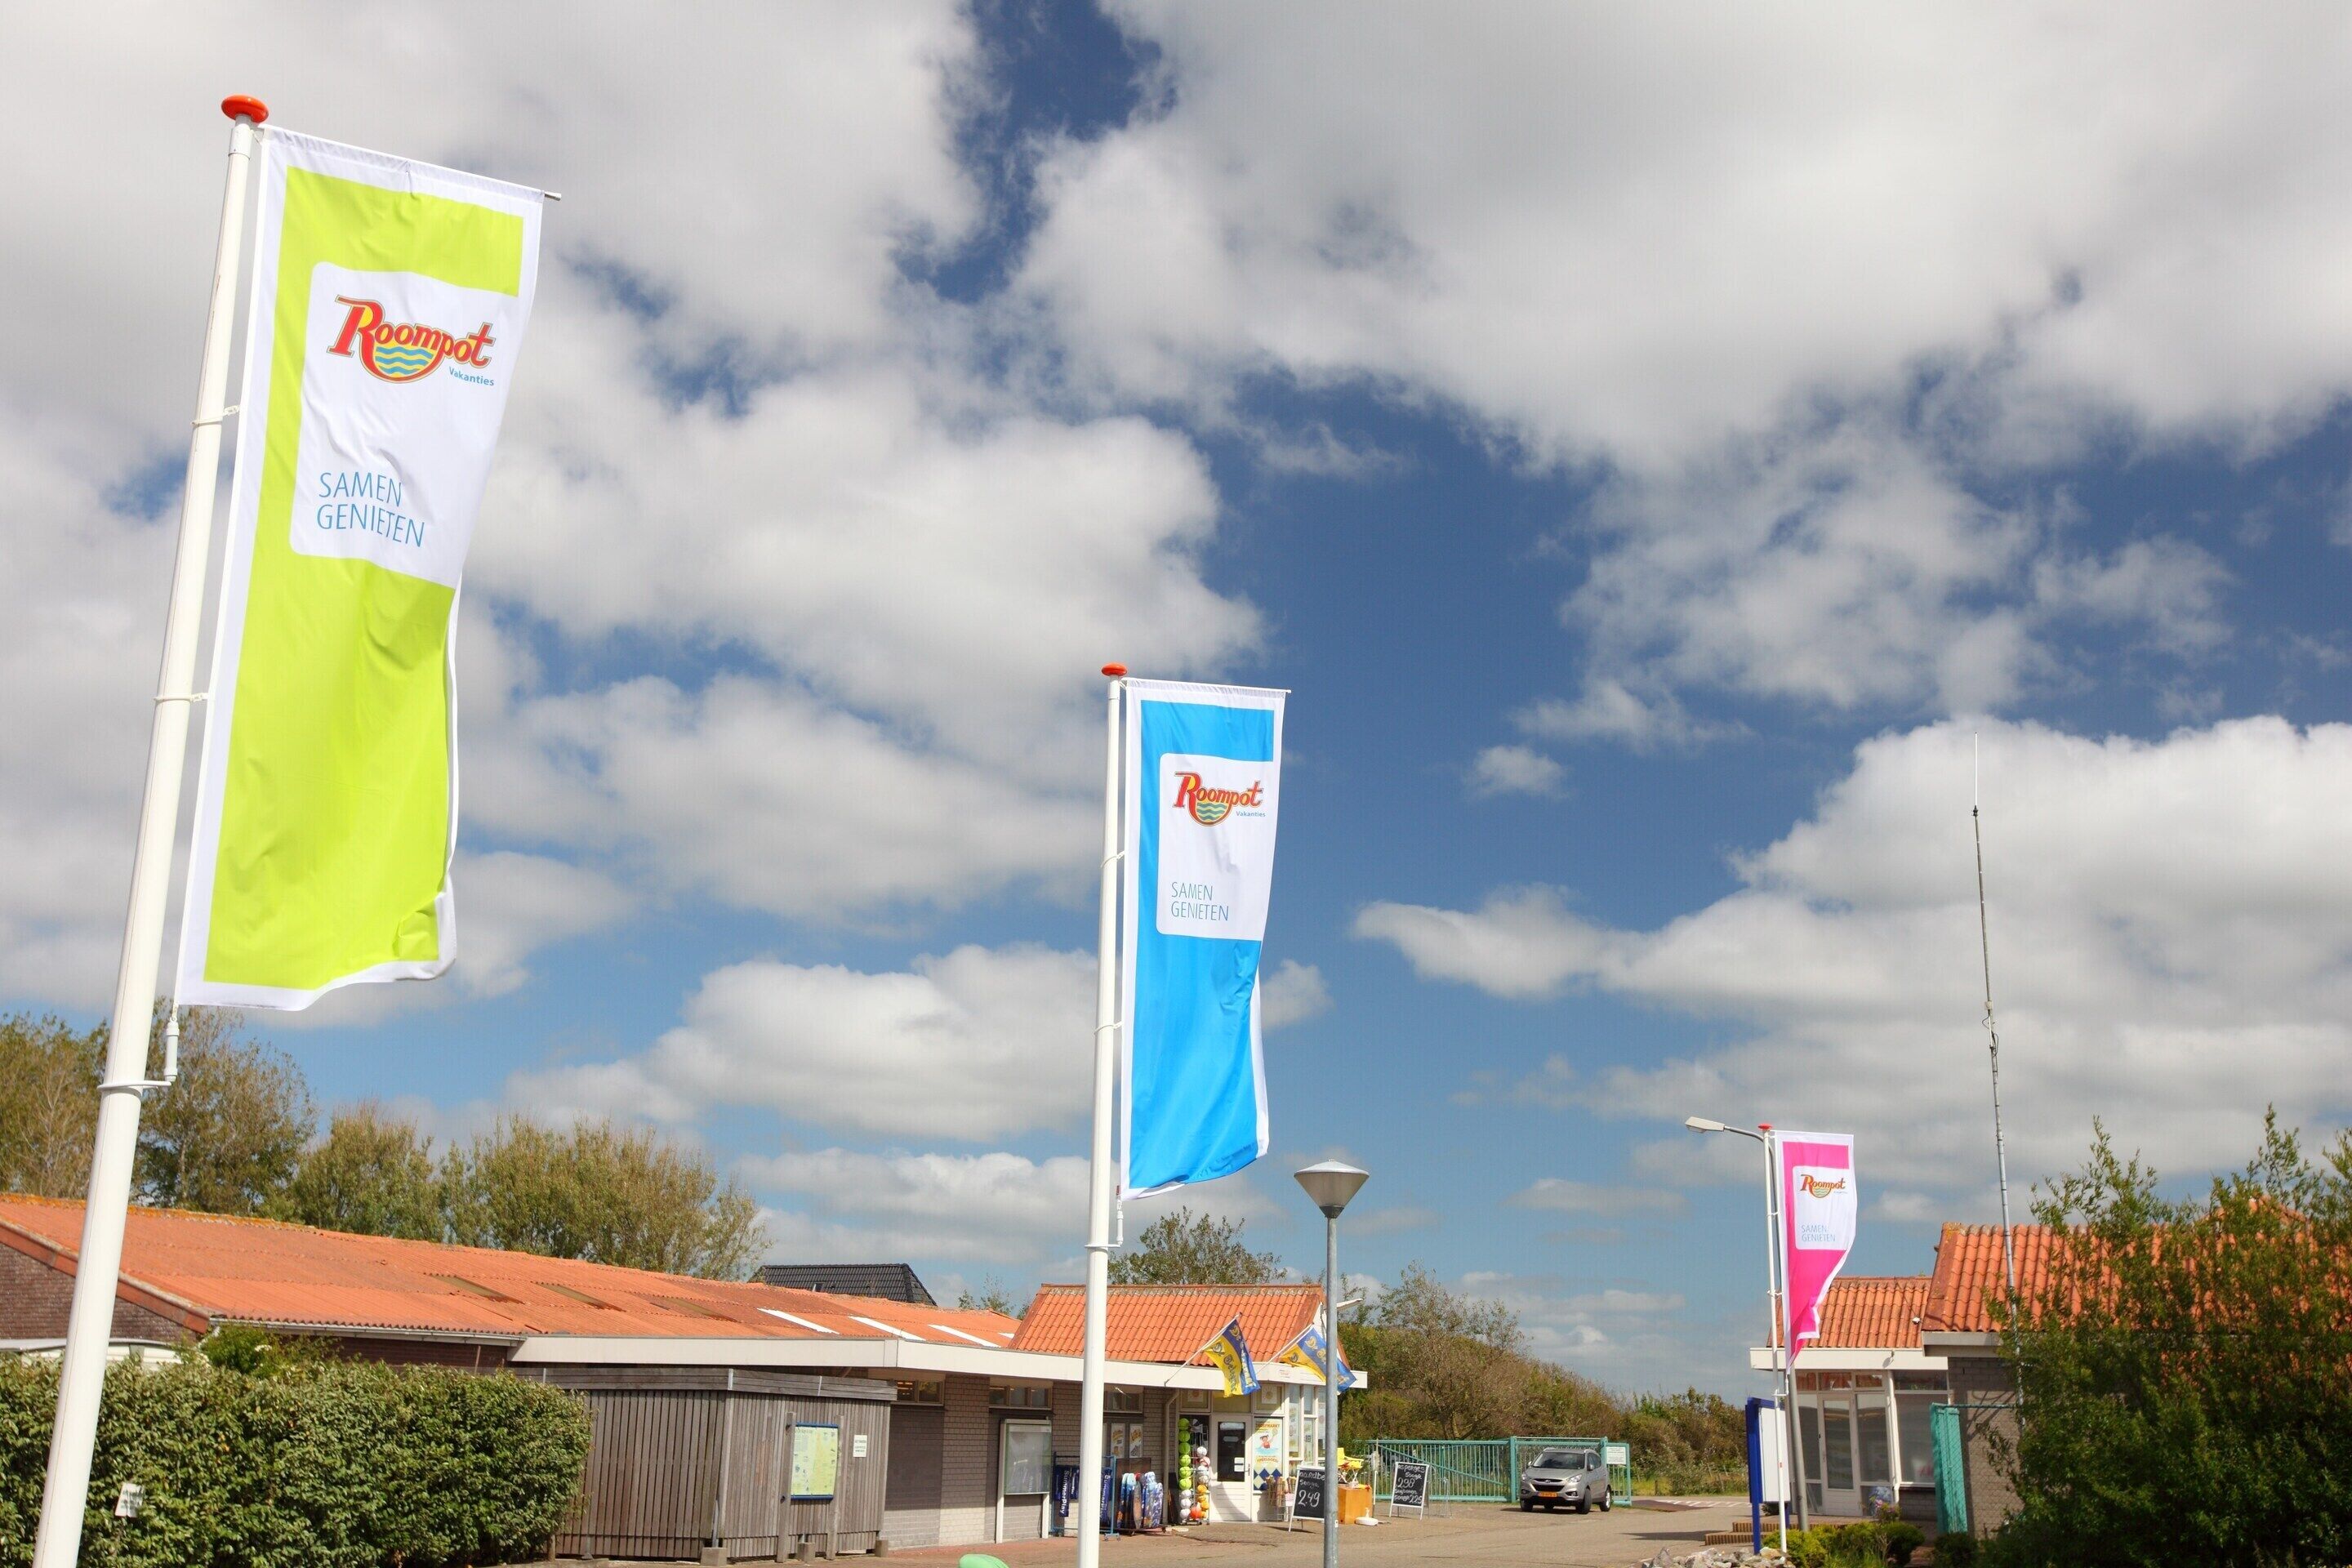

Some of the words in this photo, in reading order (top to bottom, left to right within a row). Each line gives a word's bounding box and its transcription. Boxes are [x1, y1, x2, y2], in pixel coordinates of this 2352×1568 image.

[326, 295, 497, 384] Roompot
[448, 367, 495, 387] Vakanties
[318, 471, 402, 507] SAMEN
[316, 504, 425, 548] GENIETEN
[1172, 771, 1264, 827] Roompot
[1171, 881, 1213, 901] SAMEN
[1170, 901, 1229, 921] GENIETEN
[1800, 1174, 1846, 1198] Roompot
[1801, 1224, 1827, 1233] SAMEN
[1802, 1233, 1836, 1242] GENIETEN
[1298, 1490, 1321, 1508] 2.49
